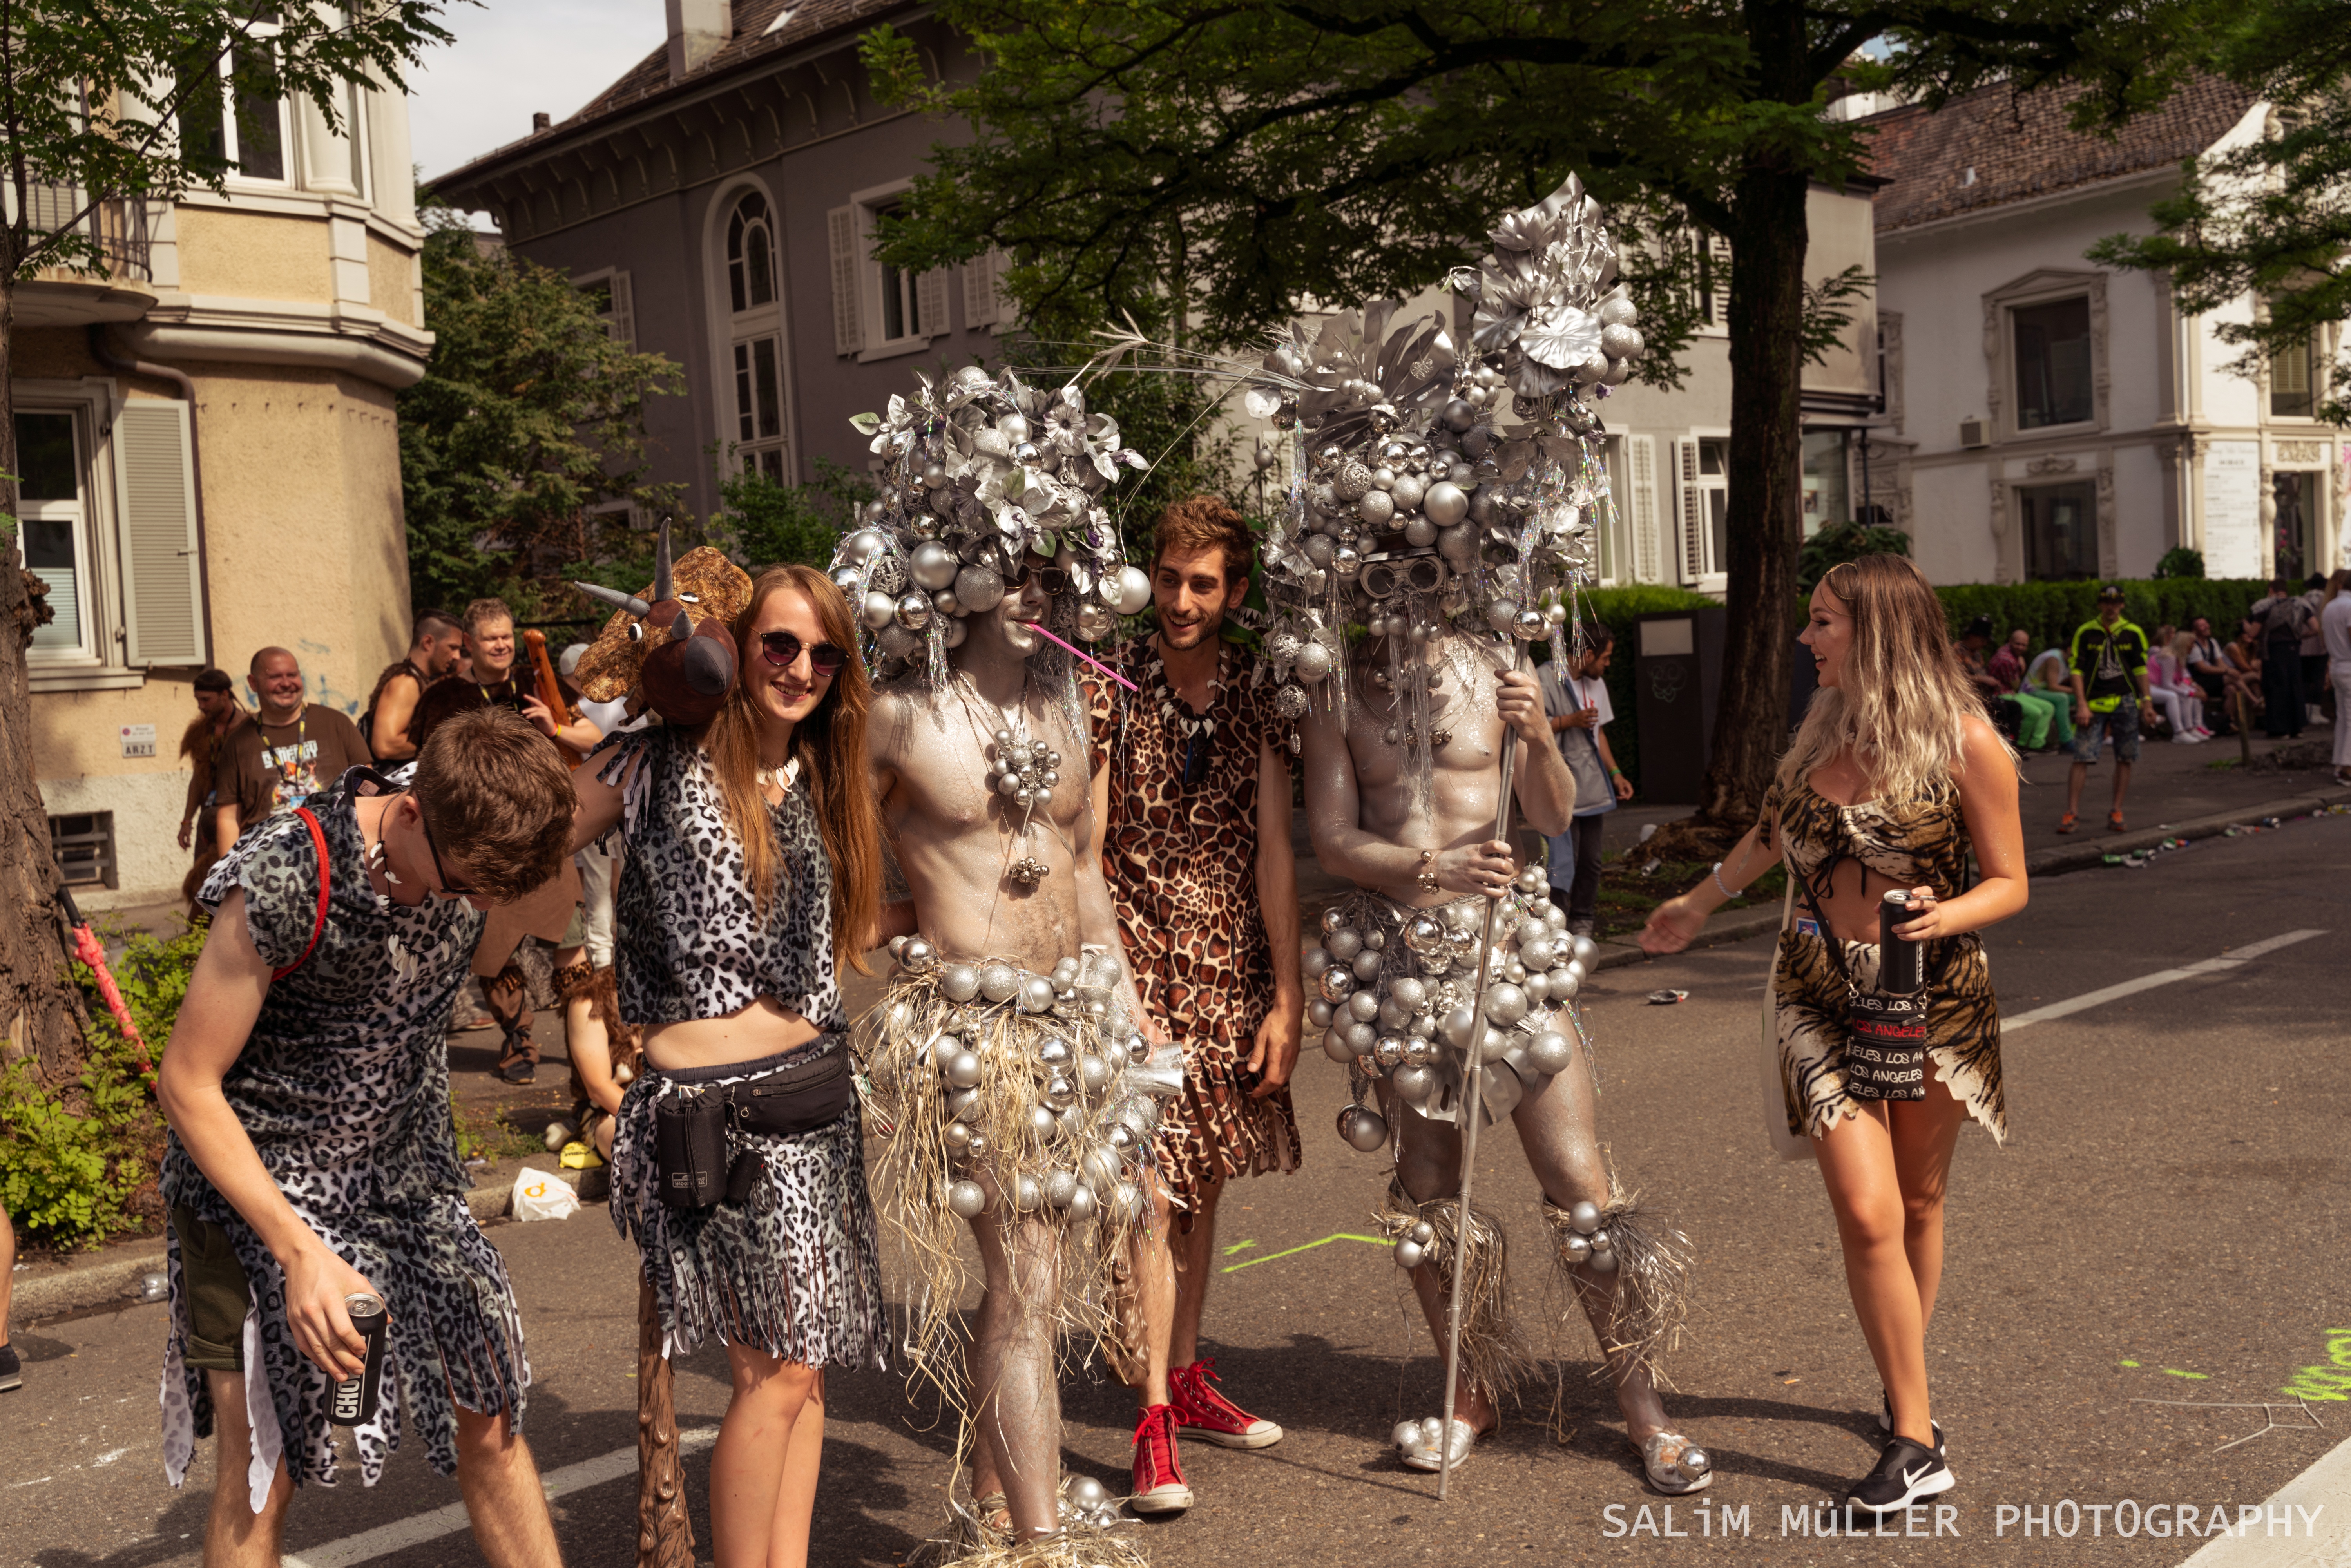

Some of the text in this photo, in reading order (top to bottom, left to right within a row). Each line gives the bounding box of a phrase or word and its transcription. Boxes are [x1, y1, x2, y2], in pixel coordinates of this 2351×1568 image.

[126, 744, 153, 755] ARZT
[261, 739, 318, 769] SNEGY
[1887, 1000, 1911, 1011] LOS
[1852, 1019, 1872, 1033] LOS
[1886, 1053, 1909, 1064] LOS
[1850, 1062, 1923, 1083] LOS ANGELES
[1884, 1090, 1908, 1098] LOS
